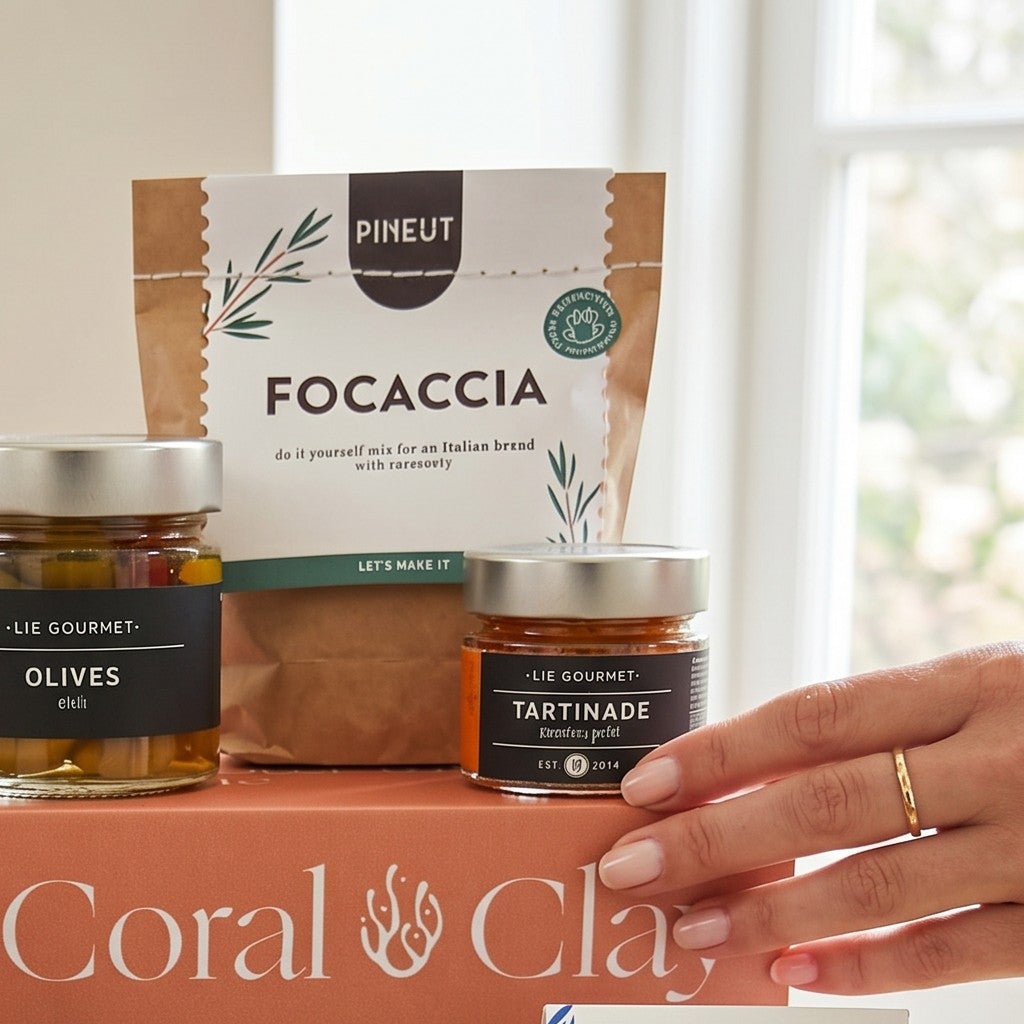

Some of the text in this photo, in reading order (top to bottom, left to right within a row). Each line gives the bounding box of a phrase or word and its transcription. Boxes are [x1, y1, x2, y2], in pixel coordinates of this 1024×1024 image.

[356, 216, 454, 244] PINEUT
[266, 367, 548, 416] FOCACCIA
[274, 448, 292, 461] do
[296, 446, 306, 459] it
[309, 444, 365, 462] yourself
[368, 443, 393, 456] mix
[397, 442, 418, 456] for
[421, 445, 438, 454] an
[442, 440, 489, 454] Italian
[355, 458, 385, 471] with
[358, 559, 450, 572] LET'S MAKE IT
[14, 620, 134, 635] LIE GOURMET
[25, 666, 120, 687] OLIVES
[532, 670, 635, 682] LIE GOURMET
[512, 701, 650, 720] TARTINADE
[538, 760, 561, 770] EST.
[592, 760, 619, 770] 2014
[2, 863, 332, 982] Coral
